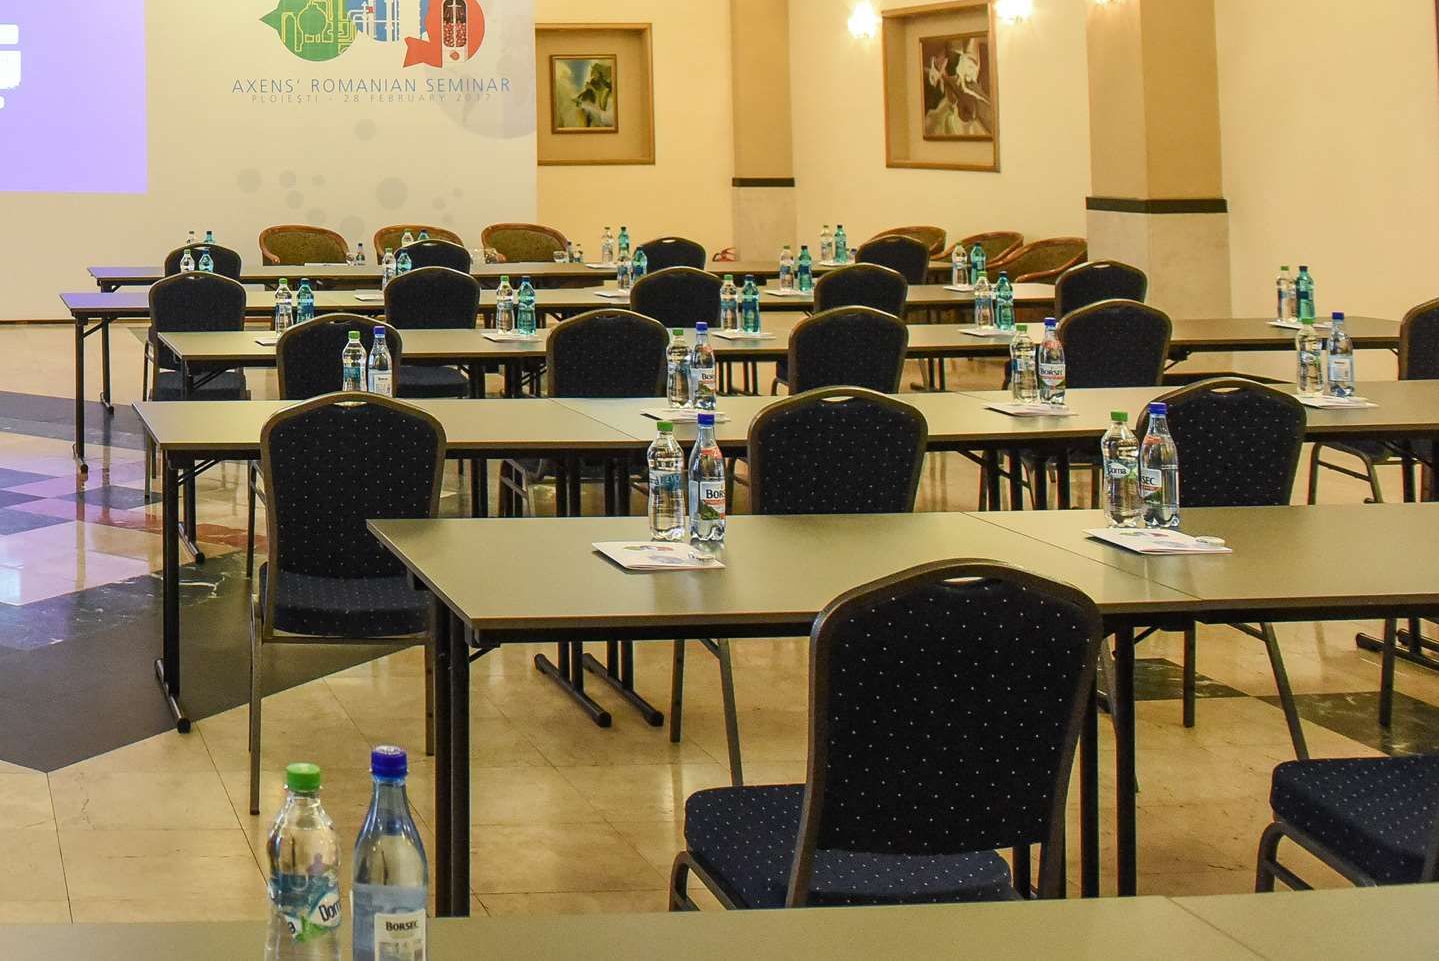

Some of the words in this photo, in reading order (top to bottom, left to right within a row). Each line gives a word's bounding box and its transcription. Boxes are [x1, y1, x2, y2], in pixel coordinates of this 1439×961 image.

[311, 78, 417, 94] ROMANIAN
[425, 77, 512, 93] SEMINAR
[343, 94, 361, 104] 28
[369, 93, 448, 104] FEBRUARY
